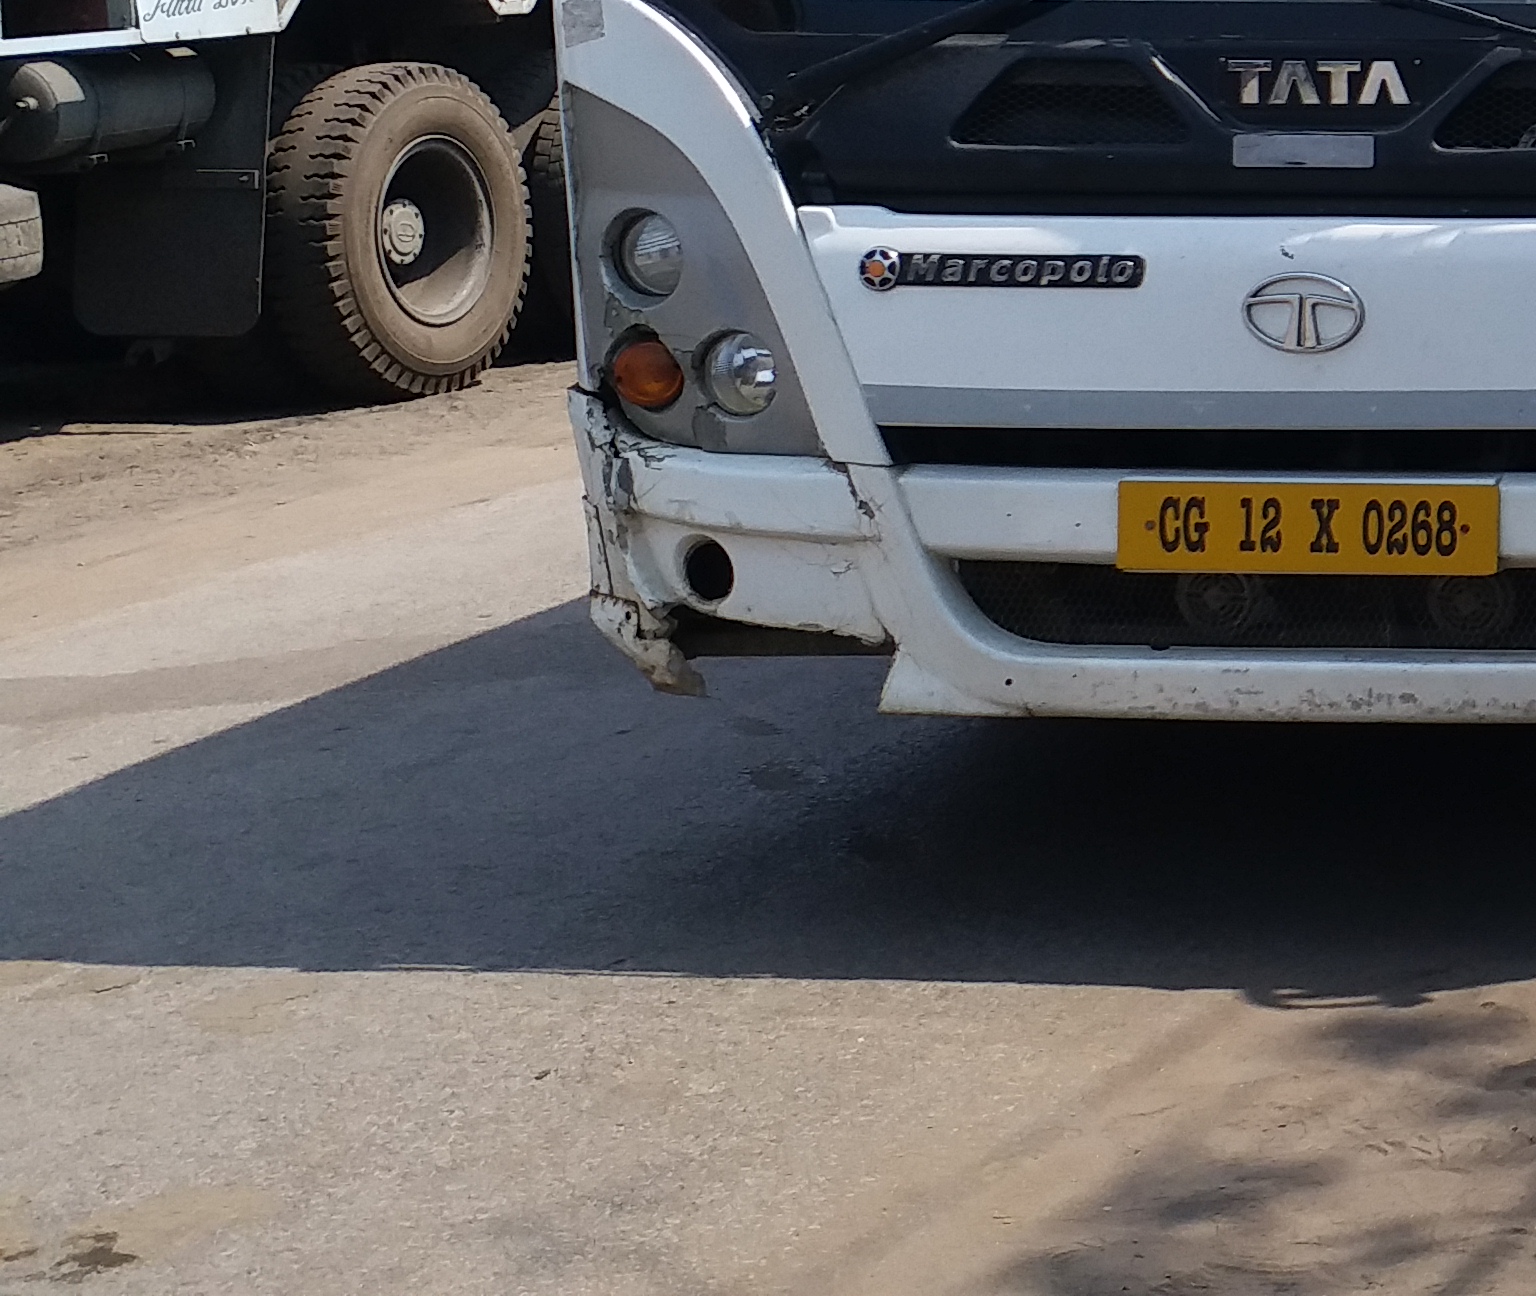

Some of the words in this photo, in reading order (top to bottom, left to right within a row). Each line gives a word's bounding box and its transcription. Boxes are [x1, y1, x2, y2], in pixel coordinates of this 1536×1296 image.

[1227, 60, 1411, 104] TATA
[907, 253, 1134, 286] Marcopolo
[1158, 495, 1210, 553] CG
[1239, 496, 1282, 554] 12
[1309, 498, 1340, 554] X
[1361, 499, 1458, 557] 0268
